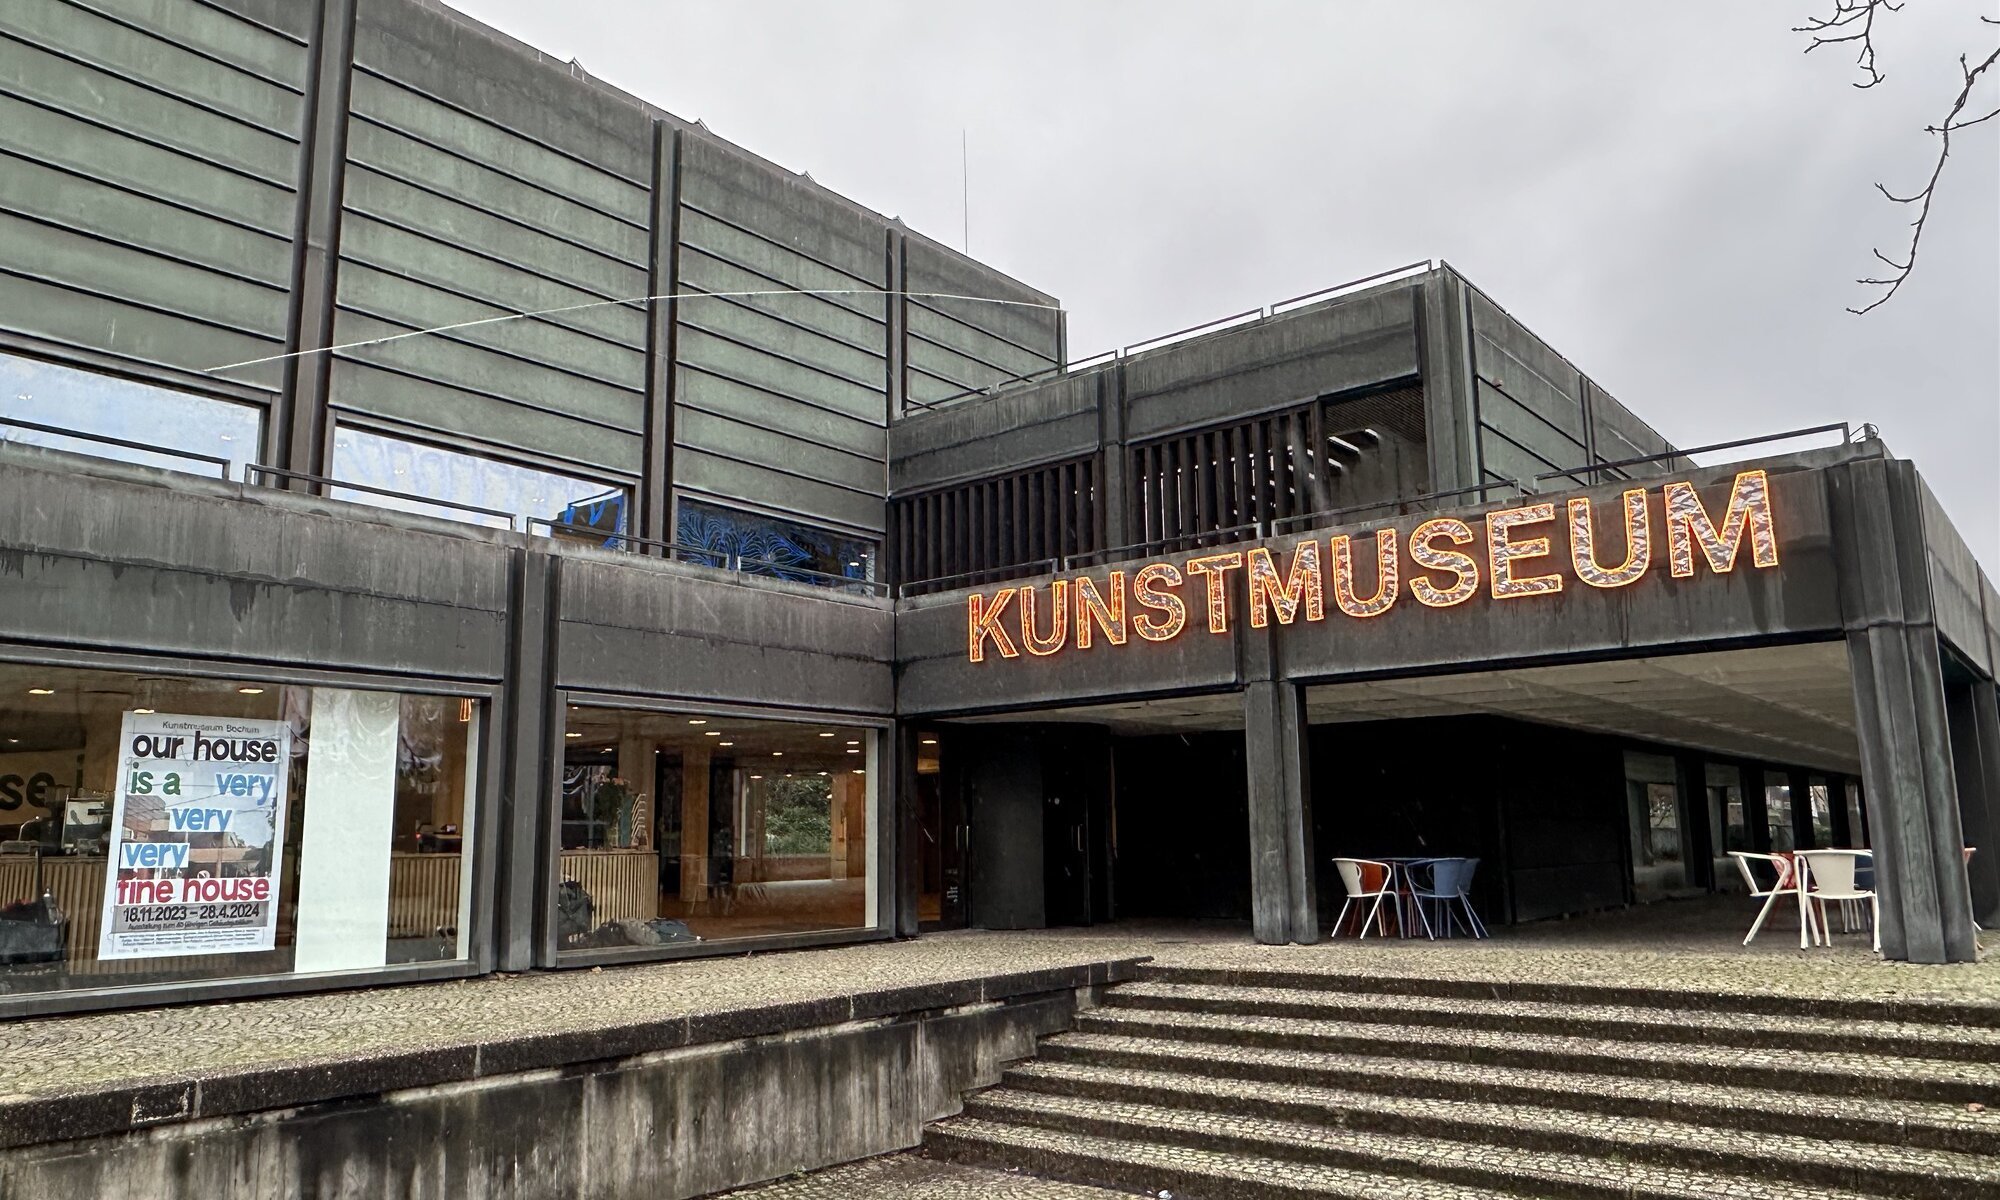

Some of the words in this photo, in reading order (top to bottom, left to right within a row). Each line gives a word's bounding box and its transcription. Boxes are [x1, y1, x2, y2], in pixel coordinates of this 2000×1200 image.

[968, 469, 1780, 663] KUNSTMUSEUM
[133, 735, 184, 760] our
[193, 730, 278, 763] house
[131, 762, 154, 795] is
[162, 772, 181, 796] a
[215, 773, 274, 806] very
[171, 807, 233, 833] very
[124, 843, 189, 870] very
[116, 872, 174, 905] fine
[180, 870, 270, 903] house
[123, 905, 187, 923] 18.11.2023
[199, 903, 260, 920] 28.4.2024
